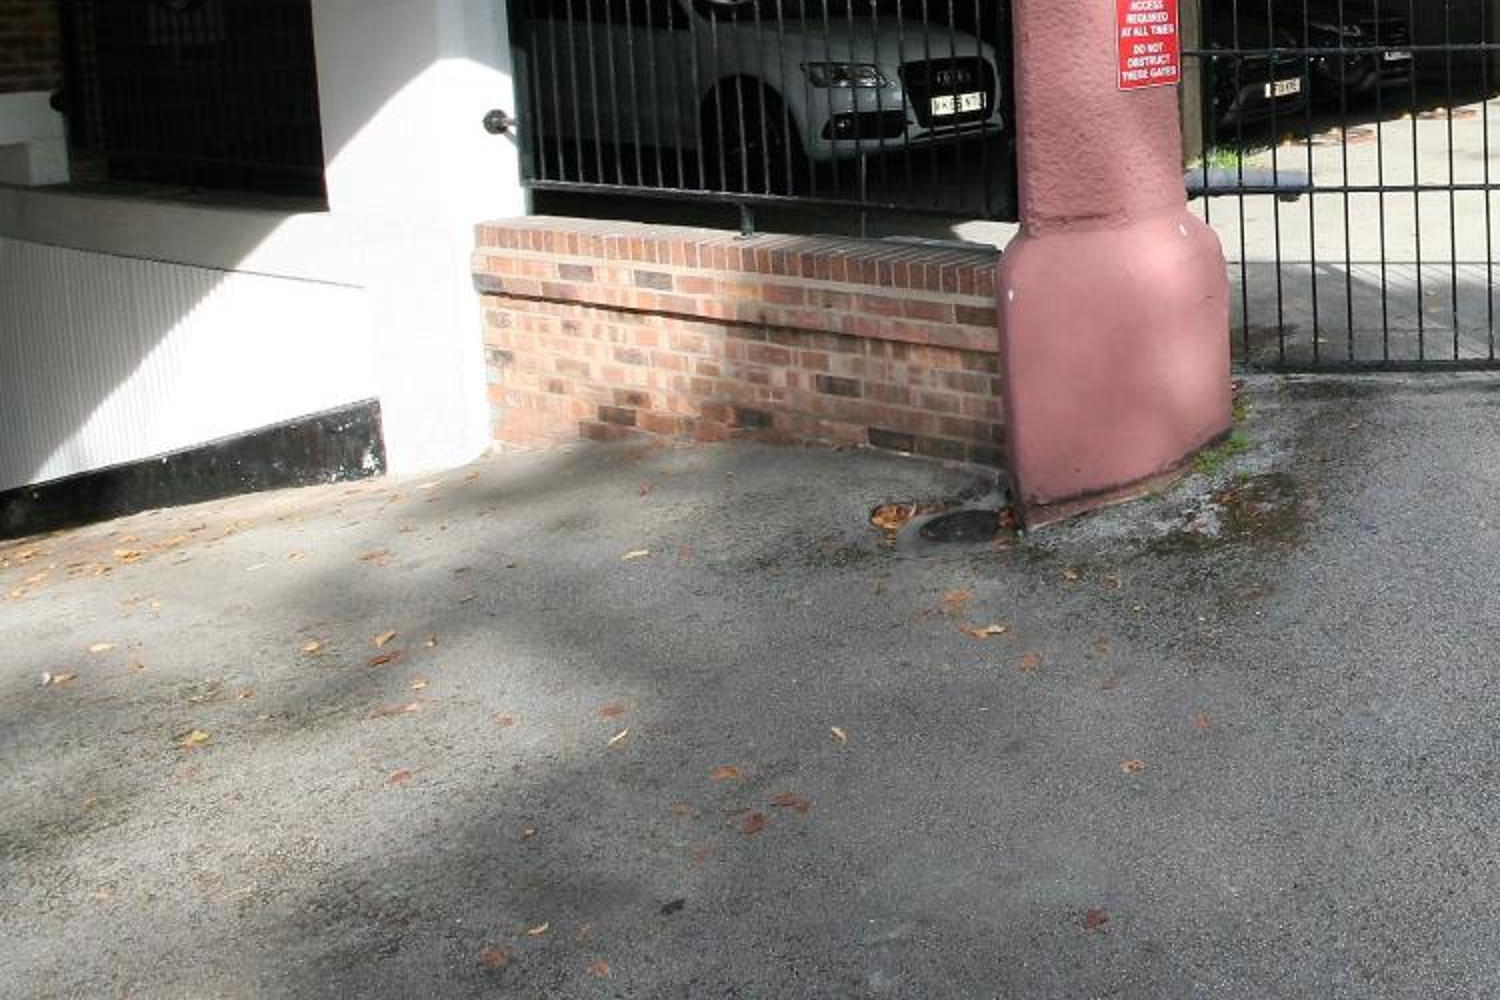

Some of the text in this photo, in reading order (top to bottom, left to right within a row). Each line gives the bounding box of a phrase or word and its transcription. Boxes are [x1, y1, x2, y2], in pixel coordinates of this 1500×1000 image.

[1126, 12, 1168, 24] REQUIRED
[1150, 24, 1174, 35] TIMES
[1133, 42, 1165, 54] DO NOT
[1127, 54, 1170, 68] OBSTRUCT
